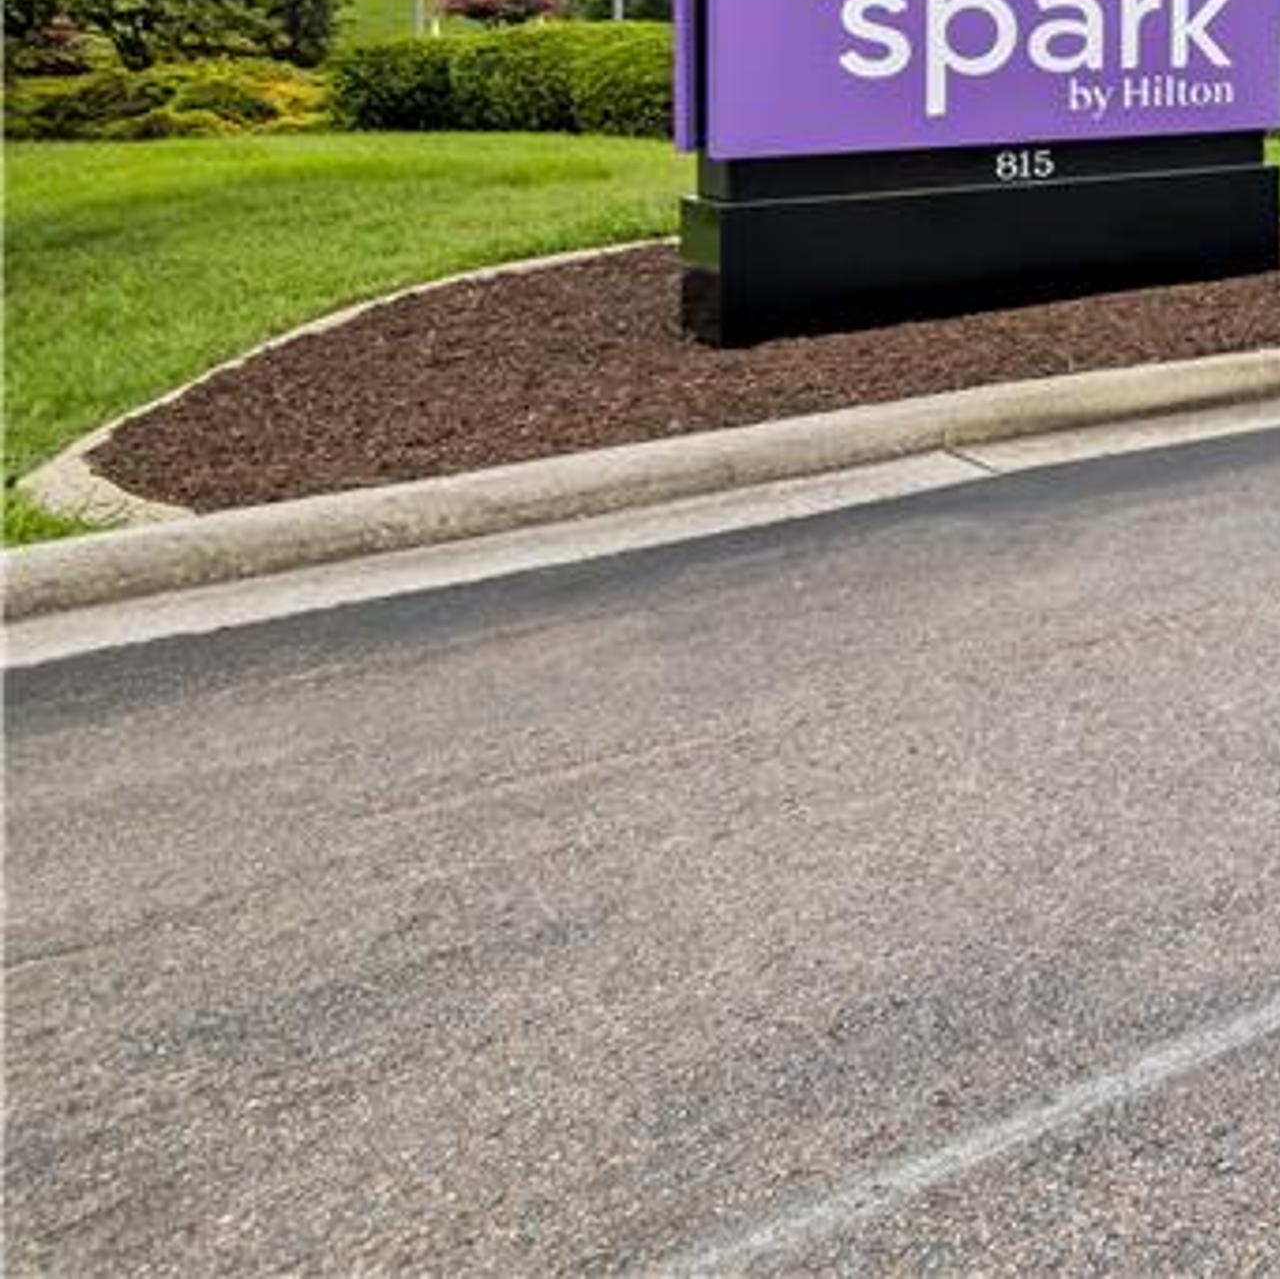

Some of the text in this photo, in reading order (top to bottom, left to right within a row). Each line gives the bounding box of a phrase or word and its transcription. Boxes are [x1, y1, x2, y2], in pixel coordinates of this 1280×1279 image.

[1069, 74, 1235, 120] by Hilton
[996, 149, 1055, 181] 815
